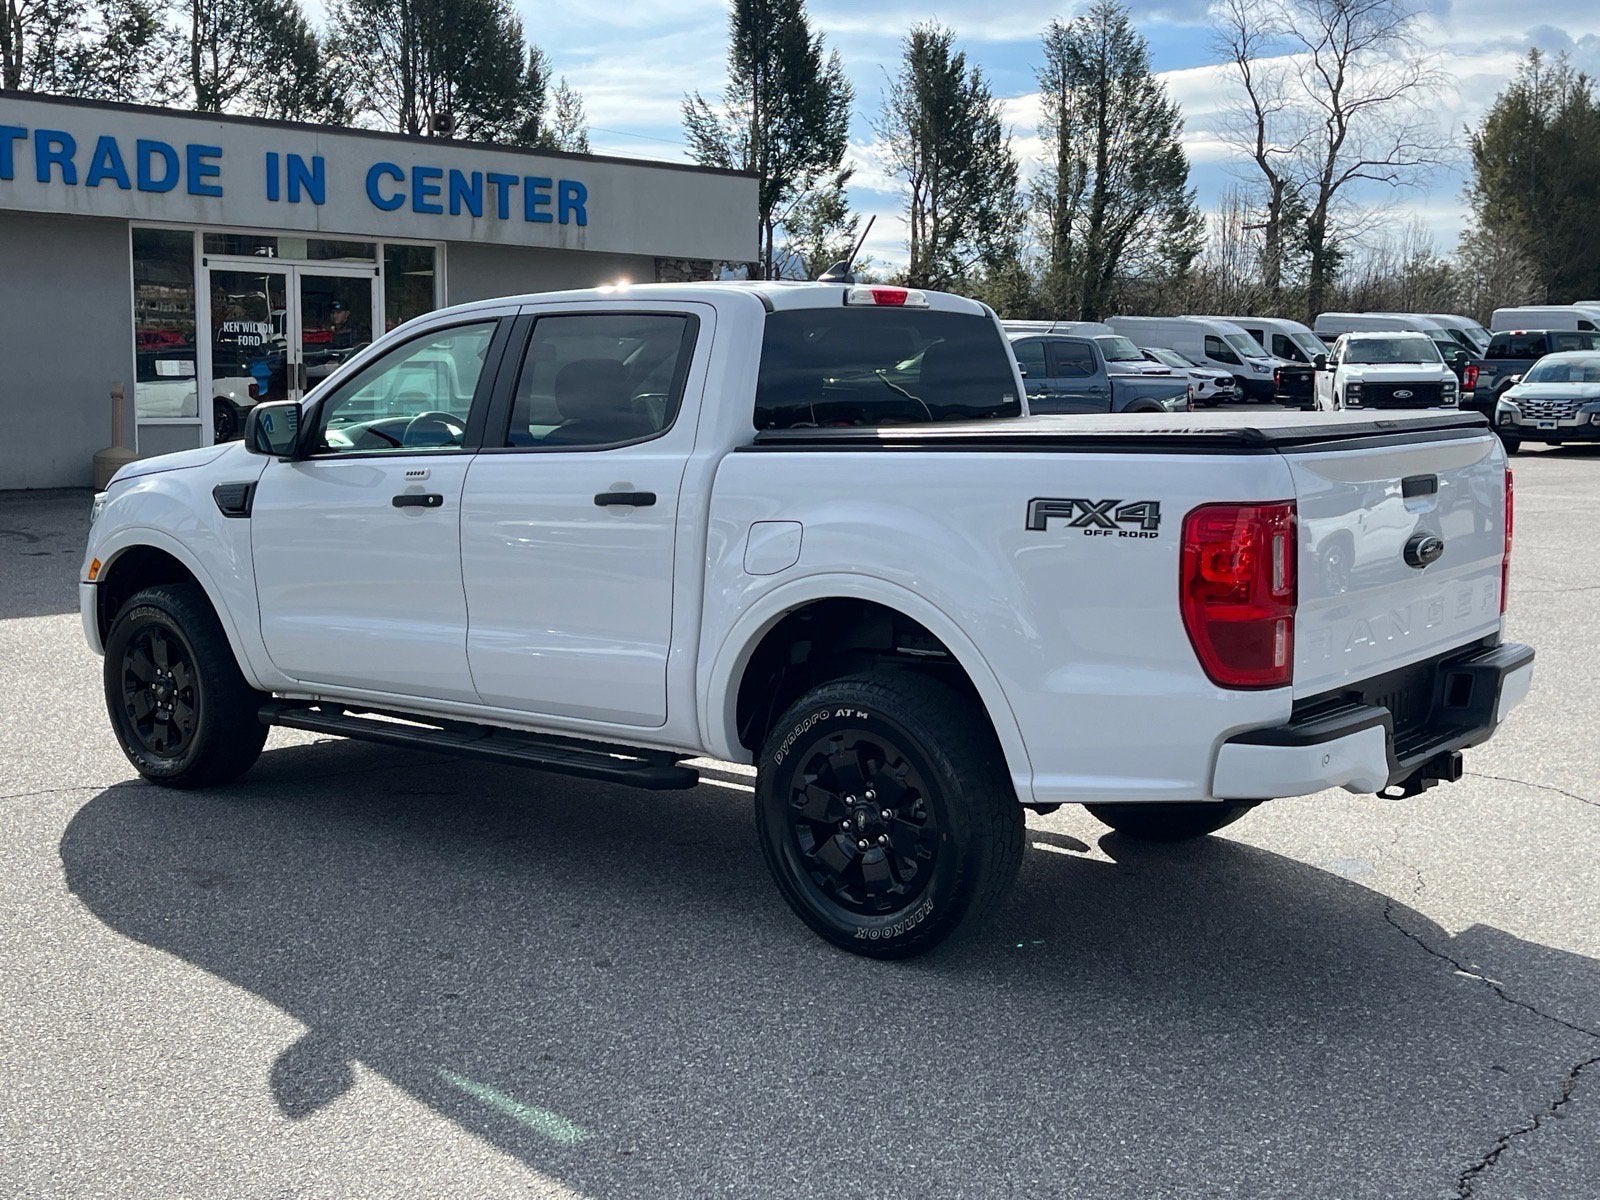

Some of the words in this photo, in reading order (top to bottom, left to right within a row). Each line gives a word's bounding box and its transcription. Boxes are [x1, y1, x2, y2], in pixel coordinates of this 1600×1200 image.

[0, 125, 223, 197] TRADE
[266, 152, 325, 205] IN
[366, 162, 588, 226] CENTER
[223, 321, 240, 333] KEN
[238, 335, 261, 346] FORD
[1025, 497, 1161, 532] FX4
[1083, 529, 1113, 537] OFF
[1118, 530, 1159, 539] ROAD
[773, 710, 830, 766] Dynapro
